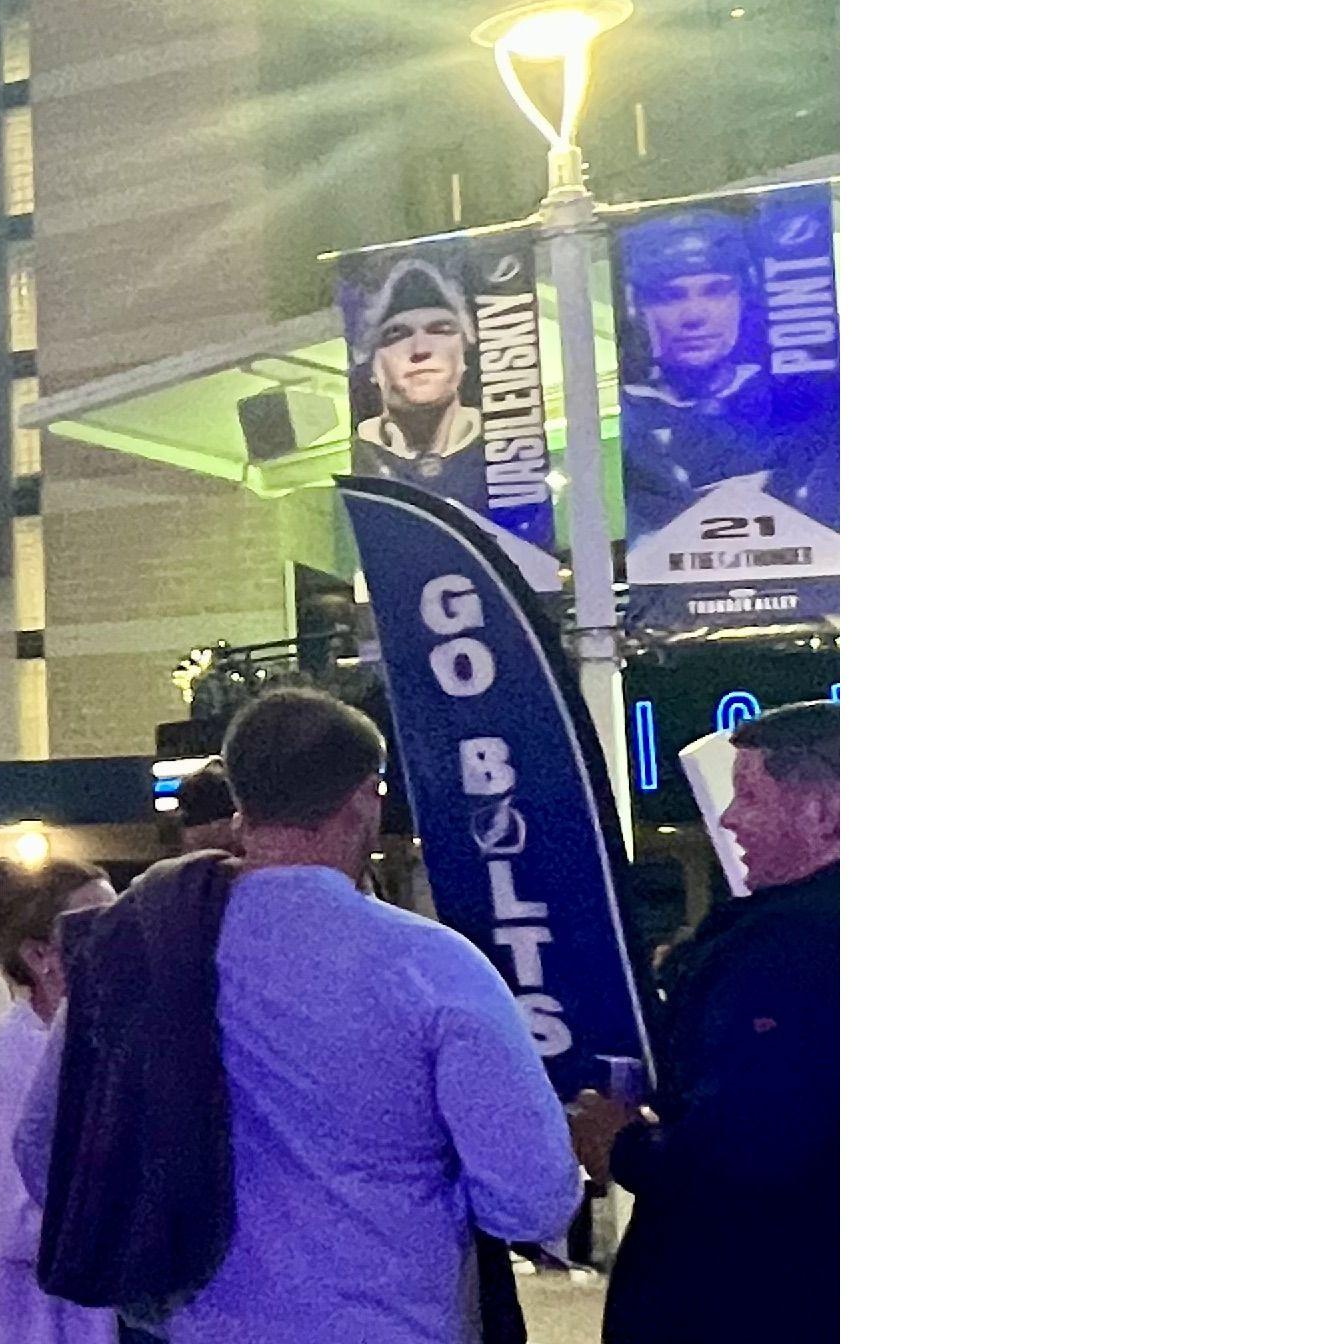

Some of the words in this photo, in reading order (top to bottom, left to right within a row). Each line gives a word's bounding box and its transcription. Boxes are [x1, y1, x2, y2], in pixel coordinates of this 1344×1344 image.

[764, 256, 837, 374] POINT
[700, 516, 777, 540] 21
[419, 573, 496, 698] GO
